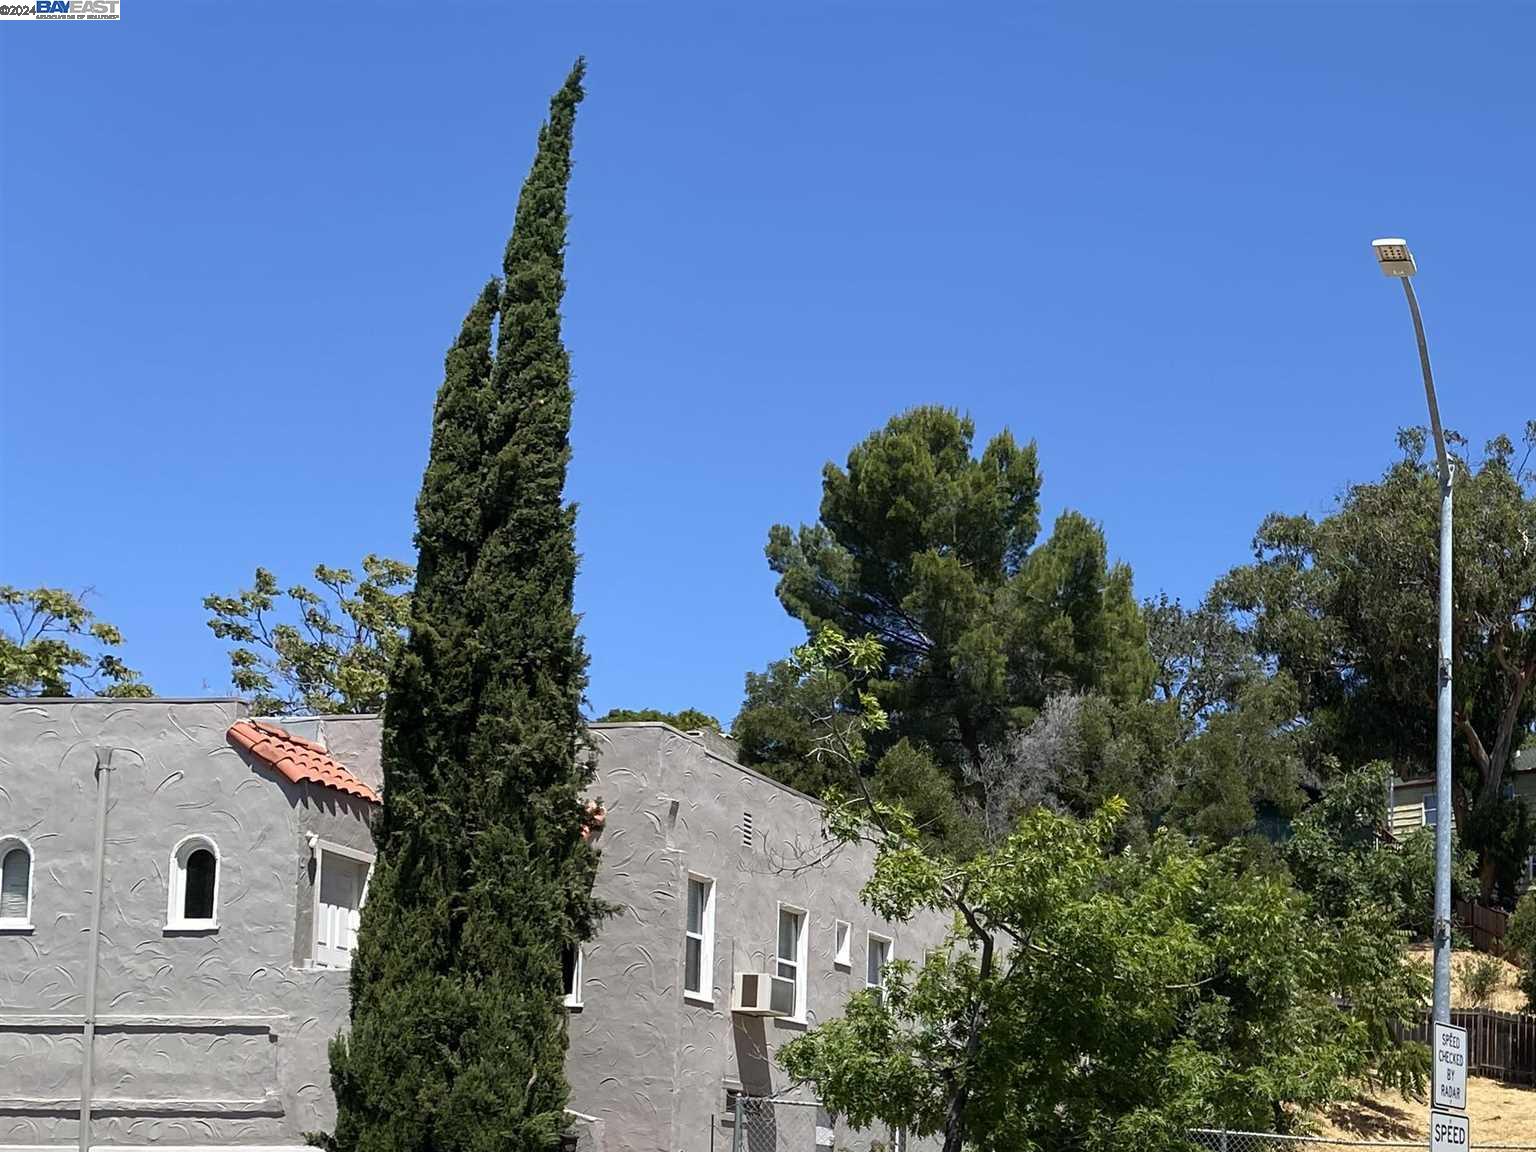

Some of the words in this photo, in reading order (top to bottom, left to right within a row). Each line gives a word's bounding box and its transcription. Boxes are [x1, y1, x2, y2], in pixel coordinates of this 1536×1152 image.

[1441, 1033, 1460, 1049] SPEED
[1439, 1050, 1464, 1067] CHECKED
[1446, 1068, 1455, 1082] BY
[1441, 1084, 1461, 1100] RADAR
[1434, 1124, 1466, 1145] SPEED
